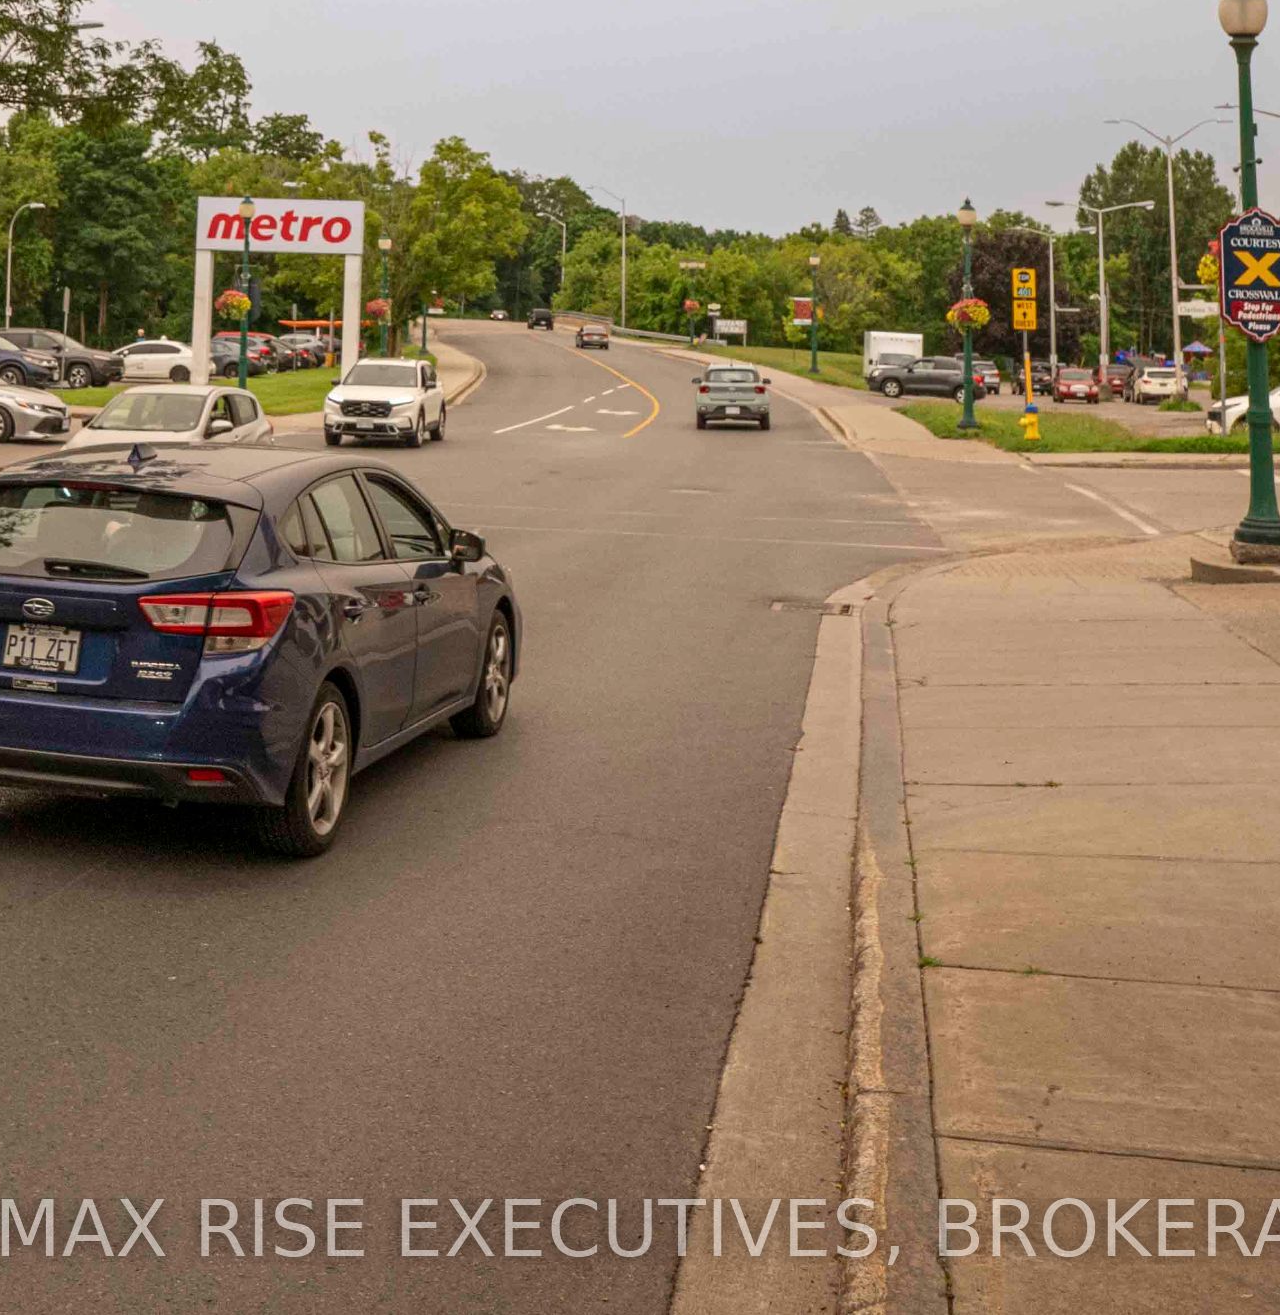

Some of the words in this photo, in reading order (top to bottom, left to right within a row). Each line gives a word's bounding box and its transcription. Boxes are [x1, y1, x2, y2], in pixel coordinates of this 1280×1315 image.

[207, 210, 352, 243] metro
[1243, 302, 1260, 312] Stop
[1261, 302, 1274, 311] For
[1238, 310, 1280, 321] Pedestrians
[1248, 321, 1271, 331] Please
